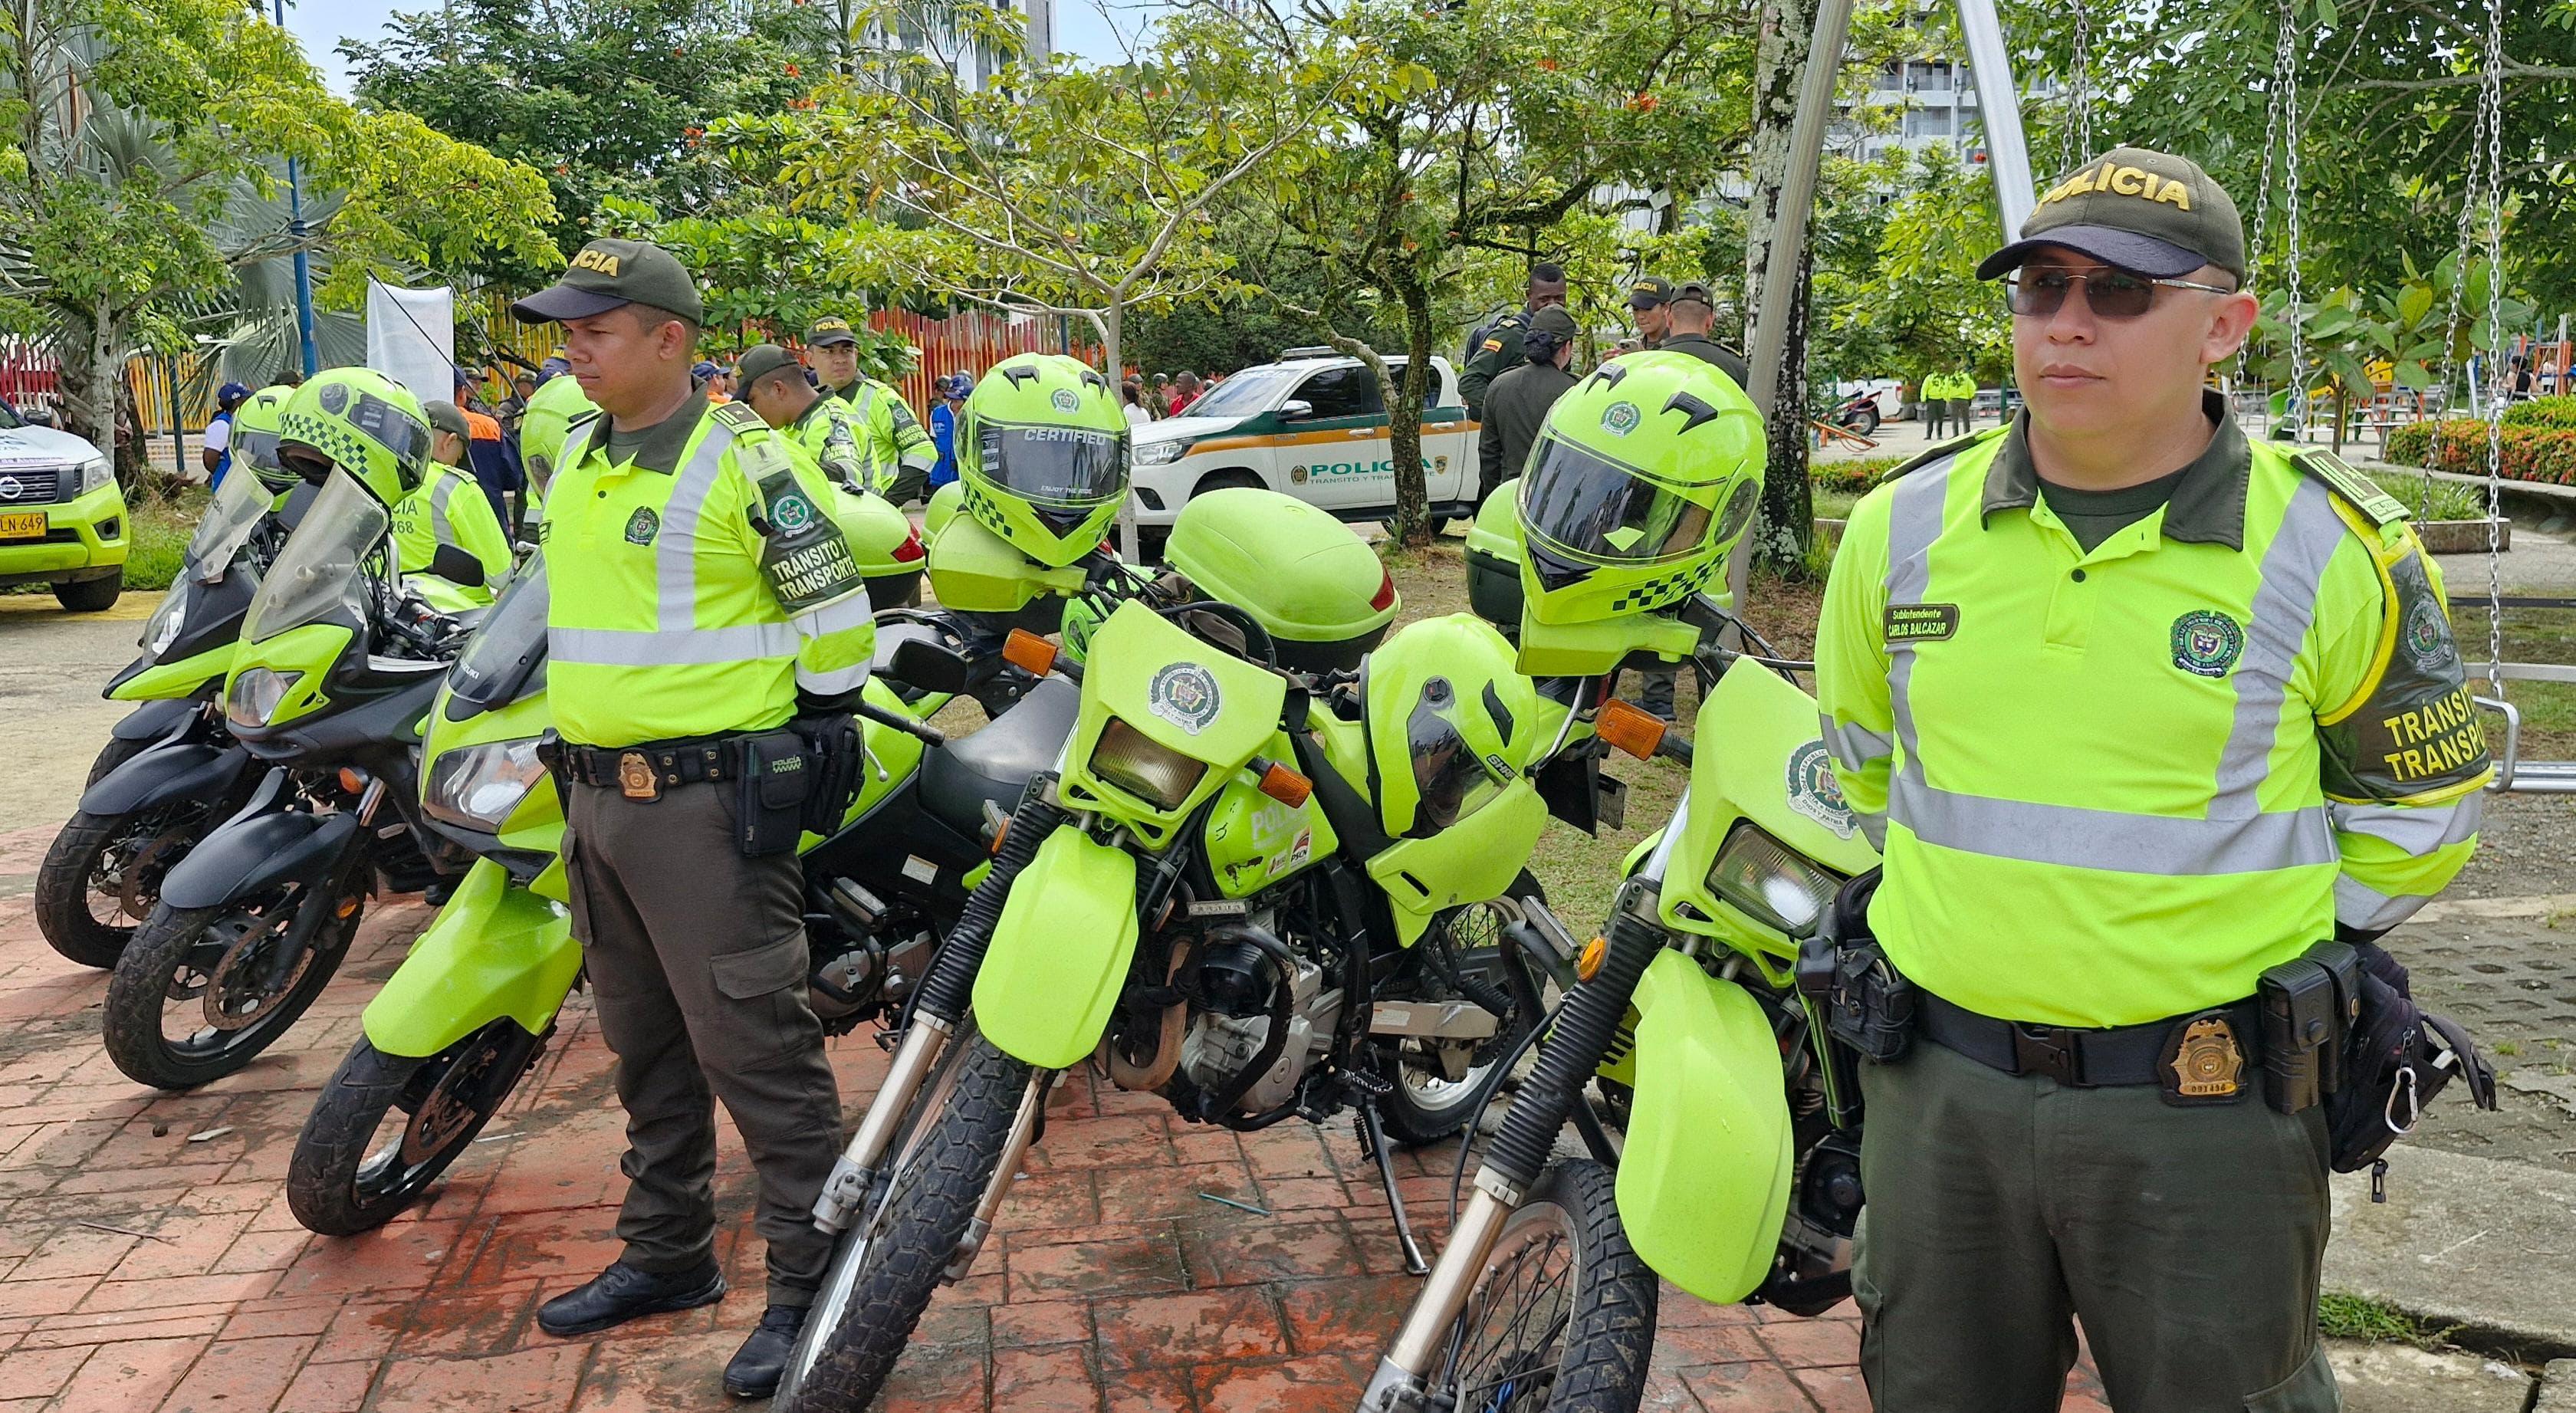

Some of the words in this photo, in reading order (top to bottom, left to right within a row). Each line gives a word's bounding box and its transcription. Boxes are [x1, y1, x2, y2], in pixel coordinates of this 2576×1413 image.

[1024, 429, 1106, 446] CERTIFIED
[1311, 458, 1433, 477] POLICA
[1309, 476, 1360, 485] TRANSITO
[20, 516, 43, 531] 649
[771, 540, 840, 582] TRÁNSITO
[837, 536, 847, 556] Y
[777, 555, 857, 600] TRANSPORTE
[1888, 623, 1909, 637] CARLOS
[1910, 622, 1947, 635] BALCAZAR
